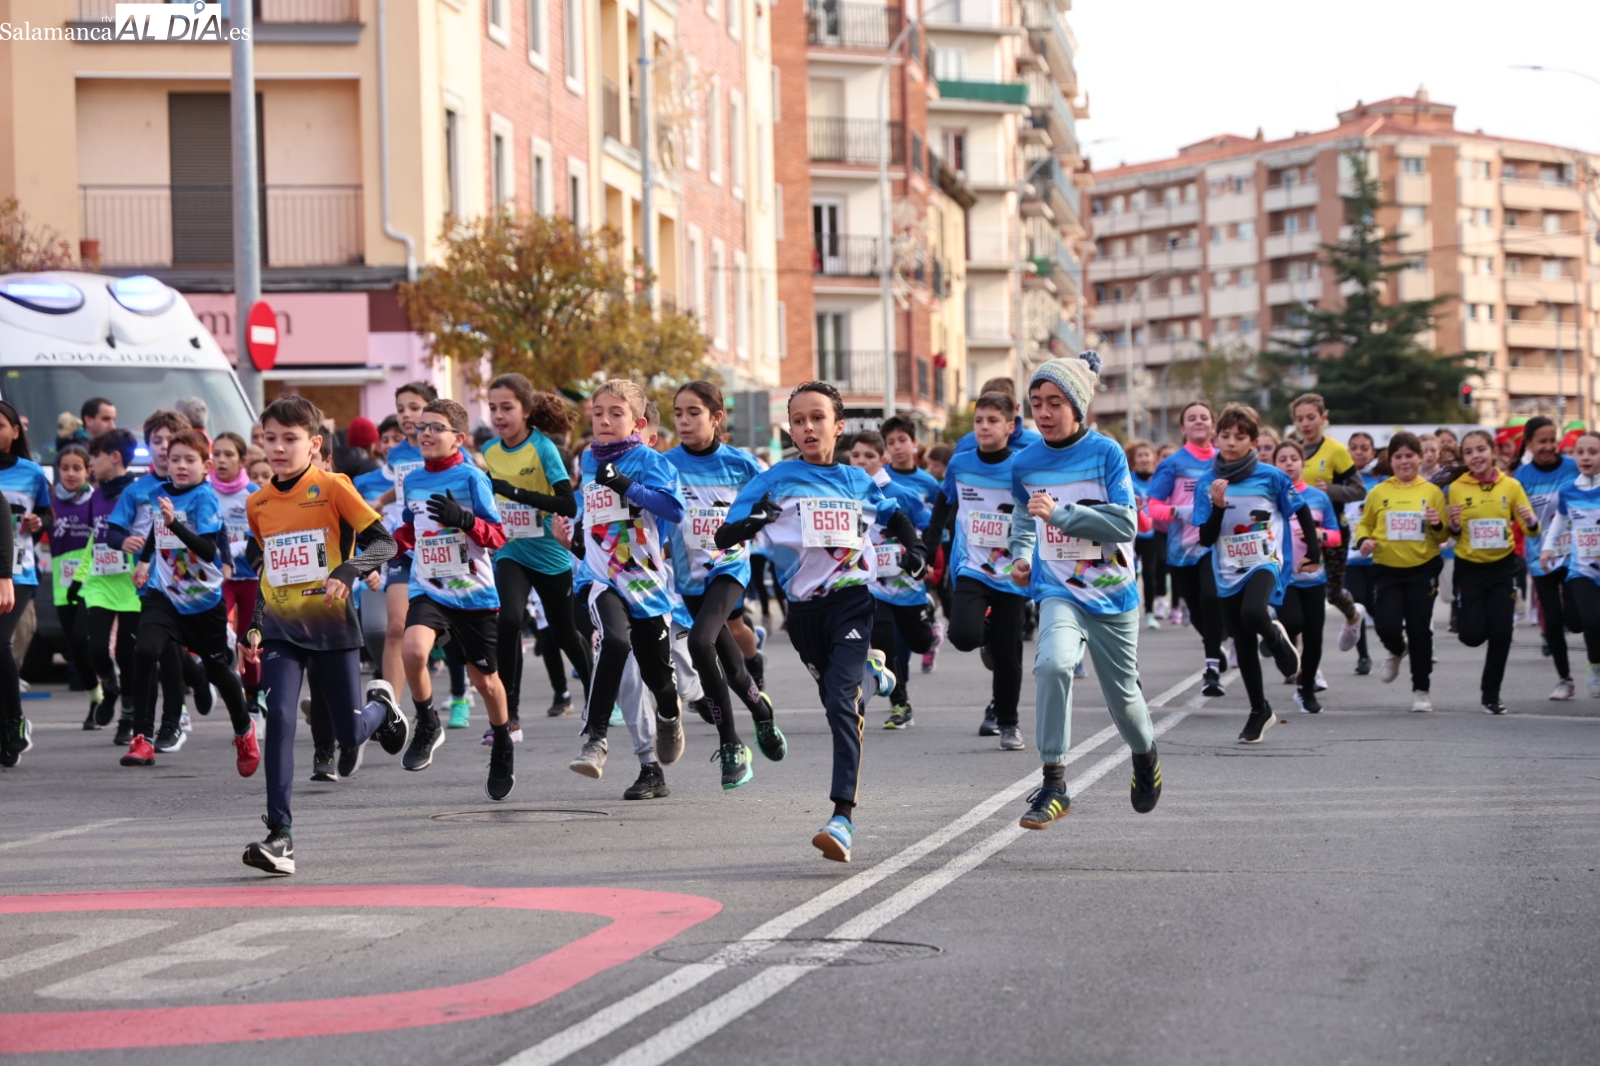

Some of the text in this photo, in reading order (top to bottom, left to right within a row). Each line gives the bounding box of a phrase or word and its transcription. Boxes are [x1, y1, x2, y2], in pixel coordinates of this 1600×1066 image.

[586, 489, 613, 513] 6455
[818, 500, 858, 511] SETEL
[501, 510, 530, 526] 6466
[813, 511, 850, 531] 6513
[979, 513, 1010, 522] SETEL
[1390, 518, 1418, 531] 6505
[692, 518, 725, 536] 643
[972, 519, 1003, 536] 6403
[1473, 526, 1500, 539] 6354
[276, 534, 317, 547] SETEL
[424, 536, 460, 546] SETEL
[1231, 532, 1261, 543] SETEL
[421, 546, 452, 565] 6481
[1227, 541, 1258, 558] 6430
[270, 545, 310, 571] 6445
[876, 553, 891, 567] 62
